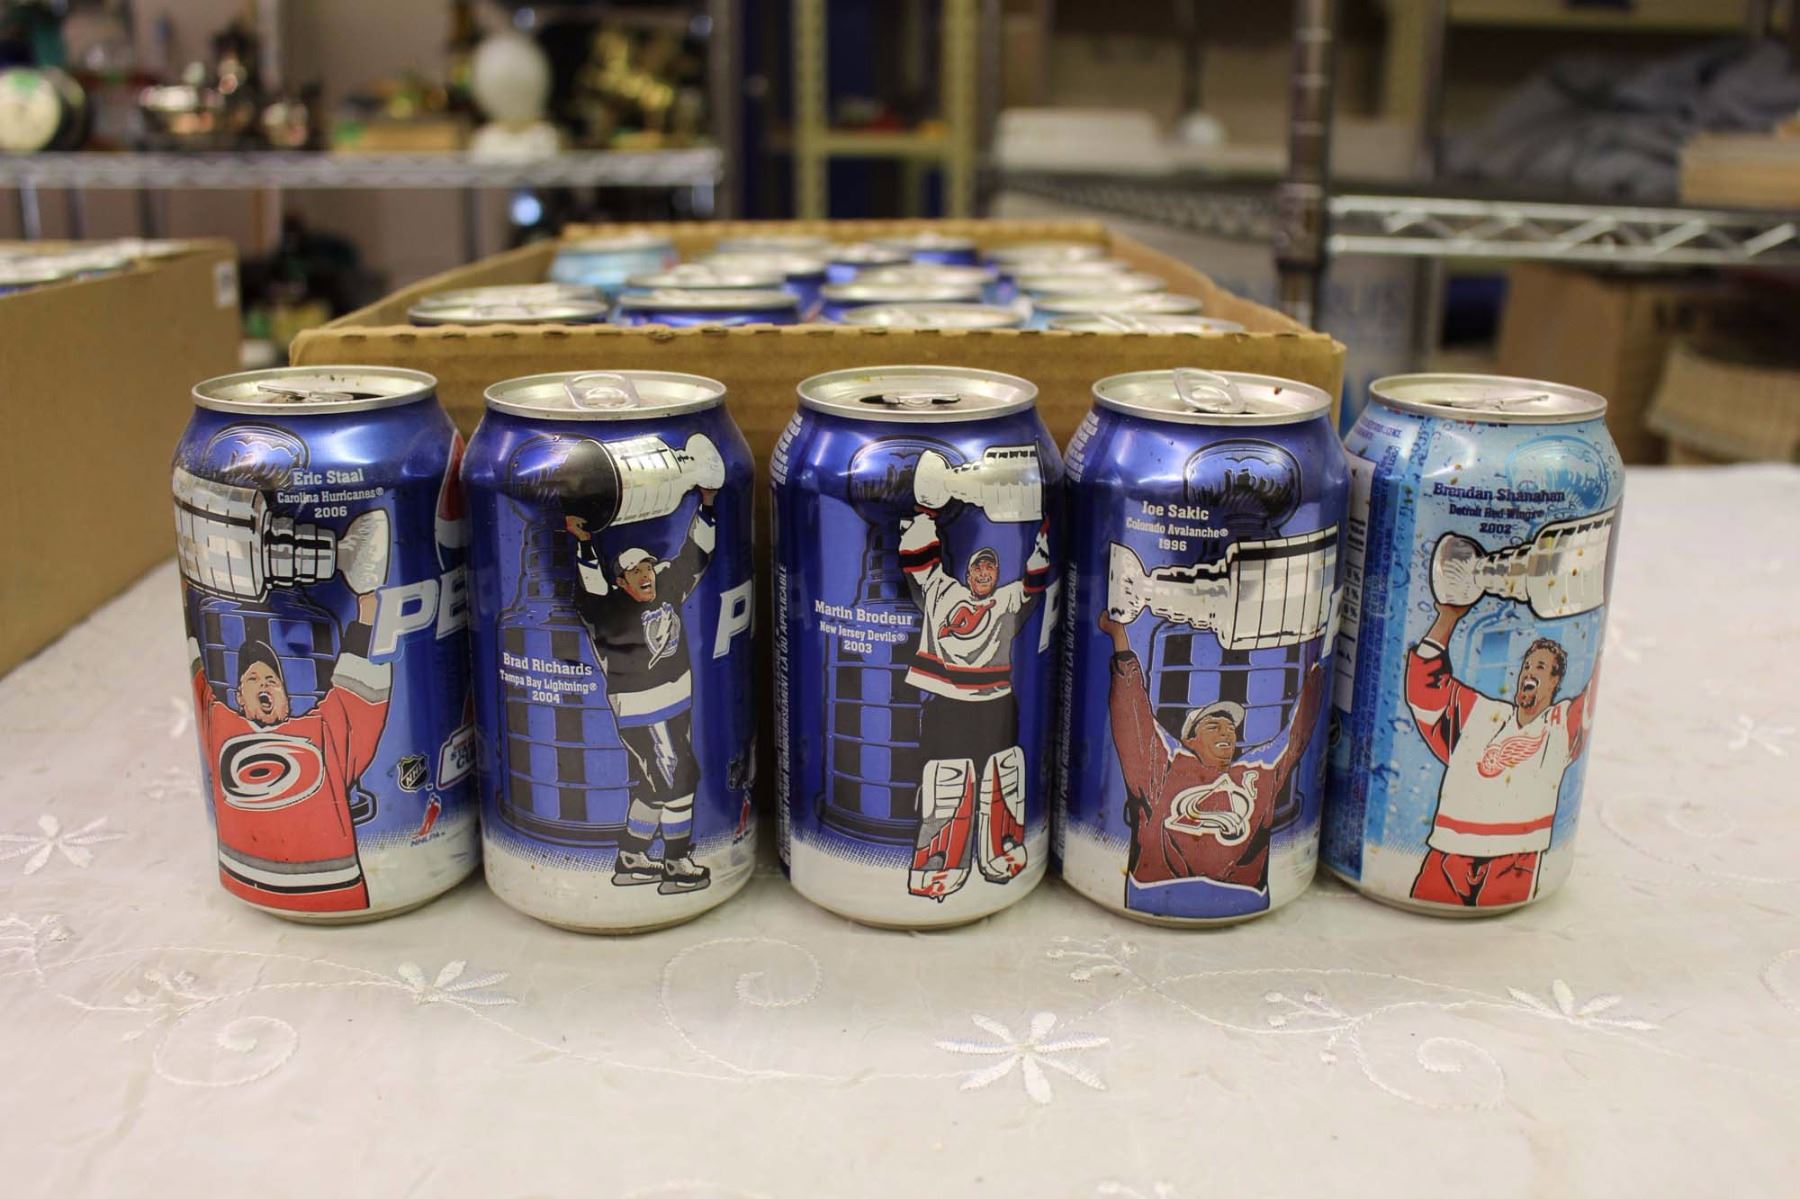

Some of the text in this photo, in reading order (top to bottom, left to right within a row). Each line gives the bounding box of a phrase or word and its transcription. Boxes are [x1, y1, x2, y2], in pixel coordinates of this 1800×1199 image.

[293, 468, 364, 485] Eric Staal
[277, 491, 319, 504] Carolina
[1433, 482, 1565, 503] Brendan Shanahan
[314, 506, 347, 518] 2006
[1142, 501, 1209, 520] Joe Sakic
[1449, 504, 1481, 517] Detroit
[1484, 507, 1504, 518] Red
[1126, 517, 1166, 534] Colorado
[1479, 523, 1512, 534] 2002
[1159, 538, 1187, 551] 1996
[778, 565, 788, 635] APPLICABLE
[815, 600, 912, 625] Martin Brodeur
[820, 621, 836, 634] New
[838, 625, 865, 641] Jersey
[844, 640, 873, 653] 2003
[503, 652, 593, 675] Brad Richards
[500, 669, 525, 686] Tampa
[526, 676, 542, 690] Bay
[532, 690, 560, 704] 2004
